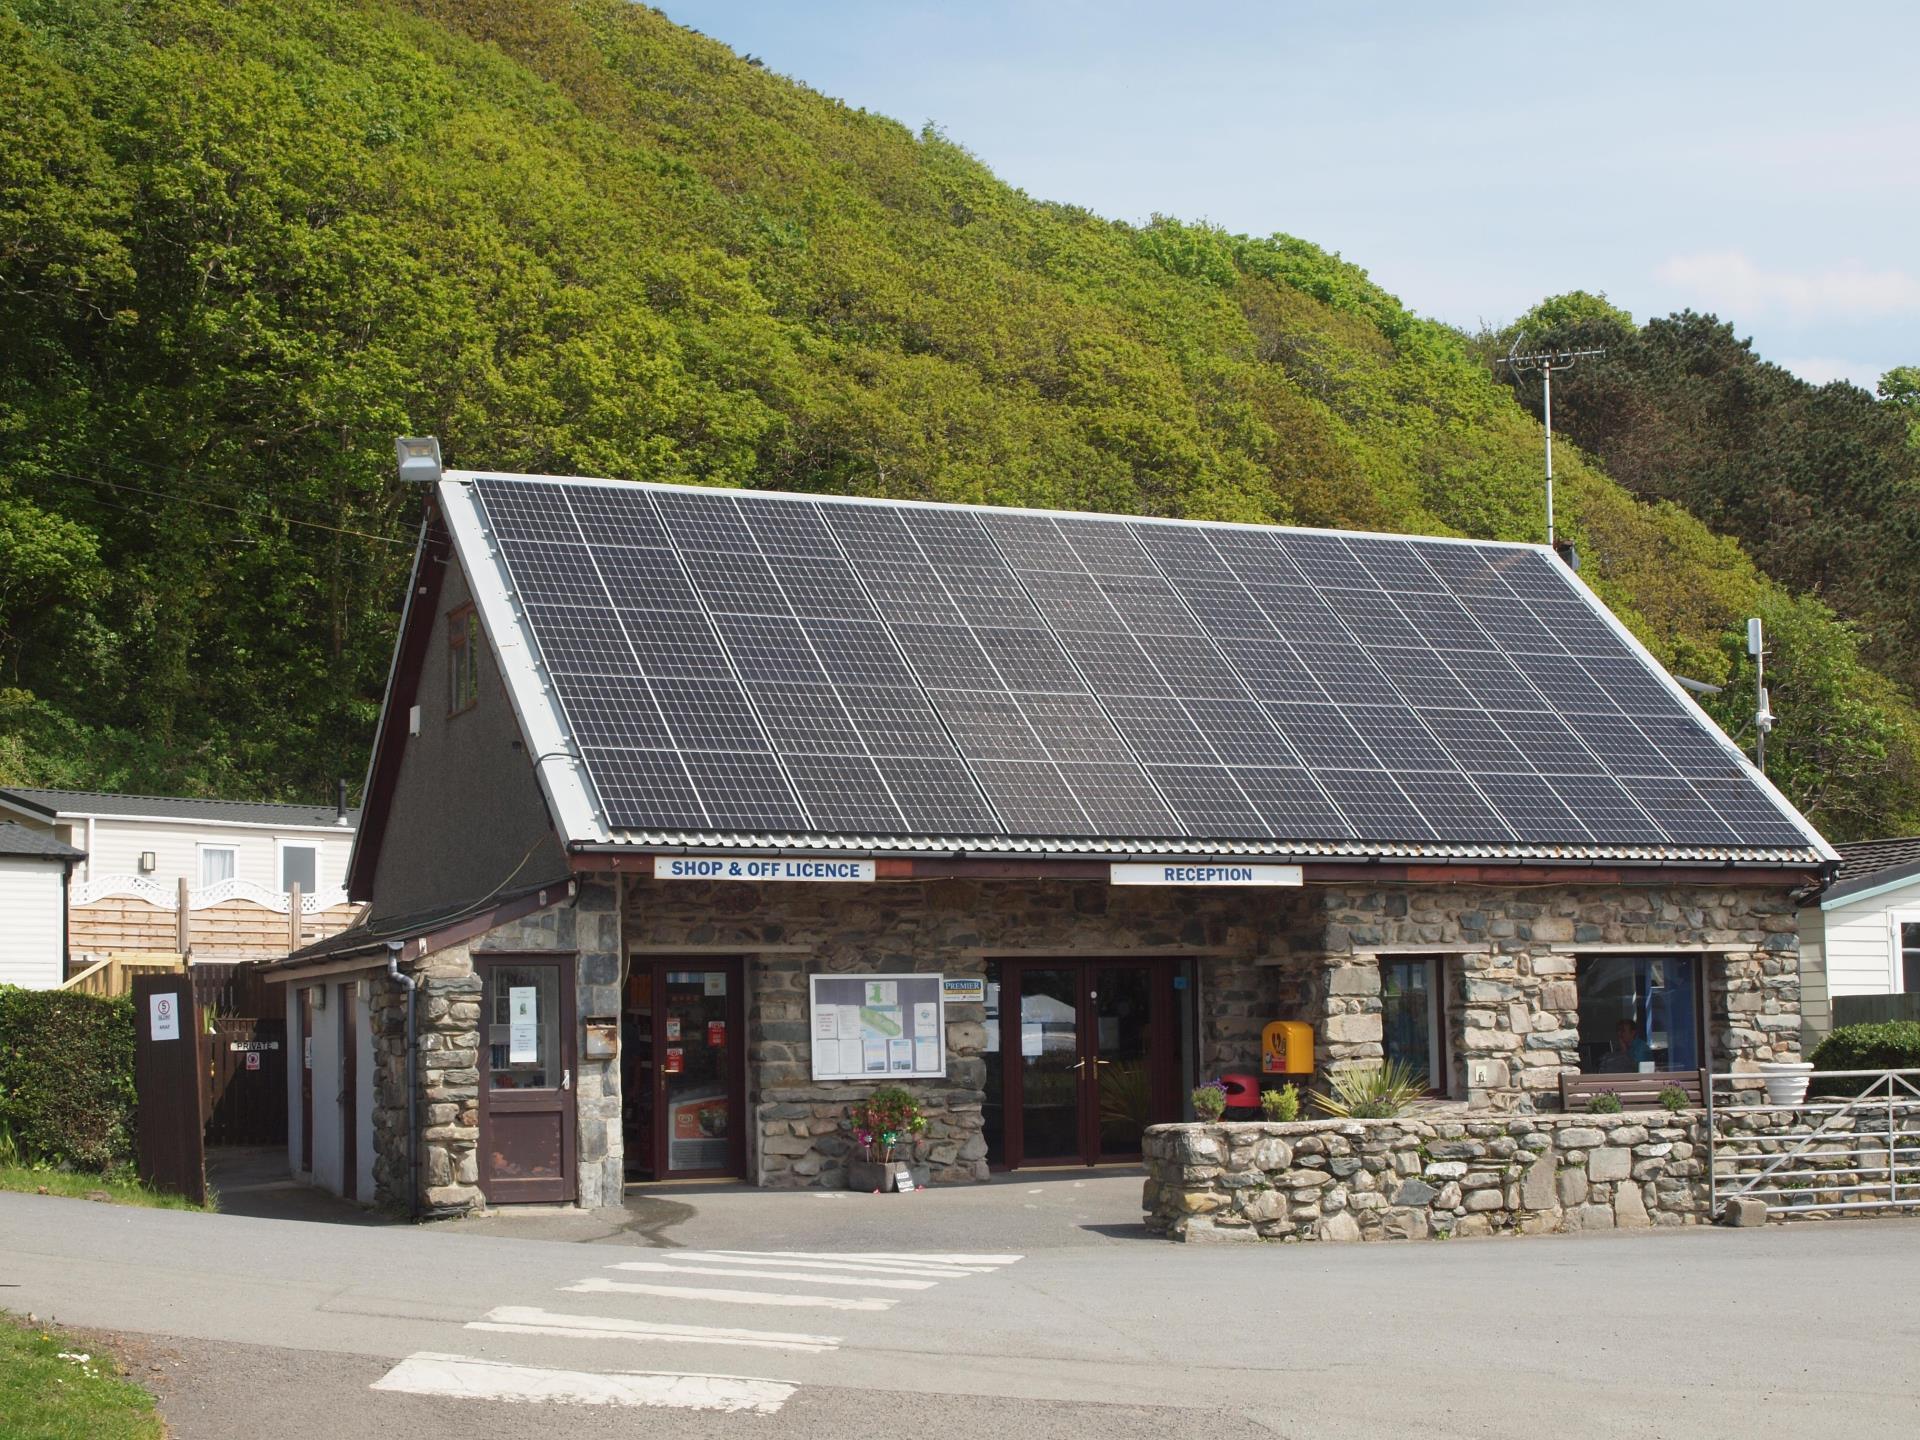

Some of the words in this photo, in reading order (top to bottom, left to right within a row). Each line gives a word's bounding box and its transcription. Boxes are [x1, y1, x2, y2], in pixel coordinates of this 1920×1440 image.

[671, 861, 723, 875] SHOP
[728, 862, 742, 876] &
[747, 862, 781, 876] OFF
[786, 863, 860, 878] LICENCE
[1164, 868, 1252, 881] RECEPTION
[945, 982, 980, 990] PREMIER
[161, 1002, 167, 1010] 5
[237, 1042, 273, 1050] PRIVATE
